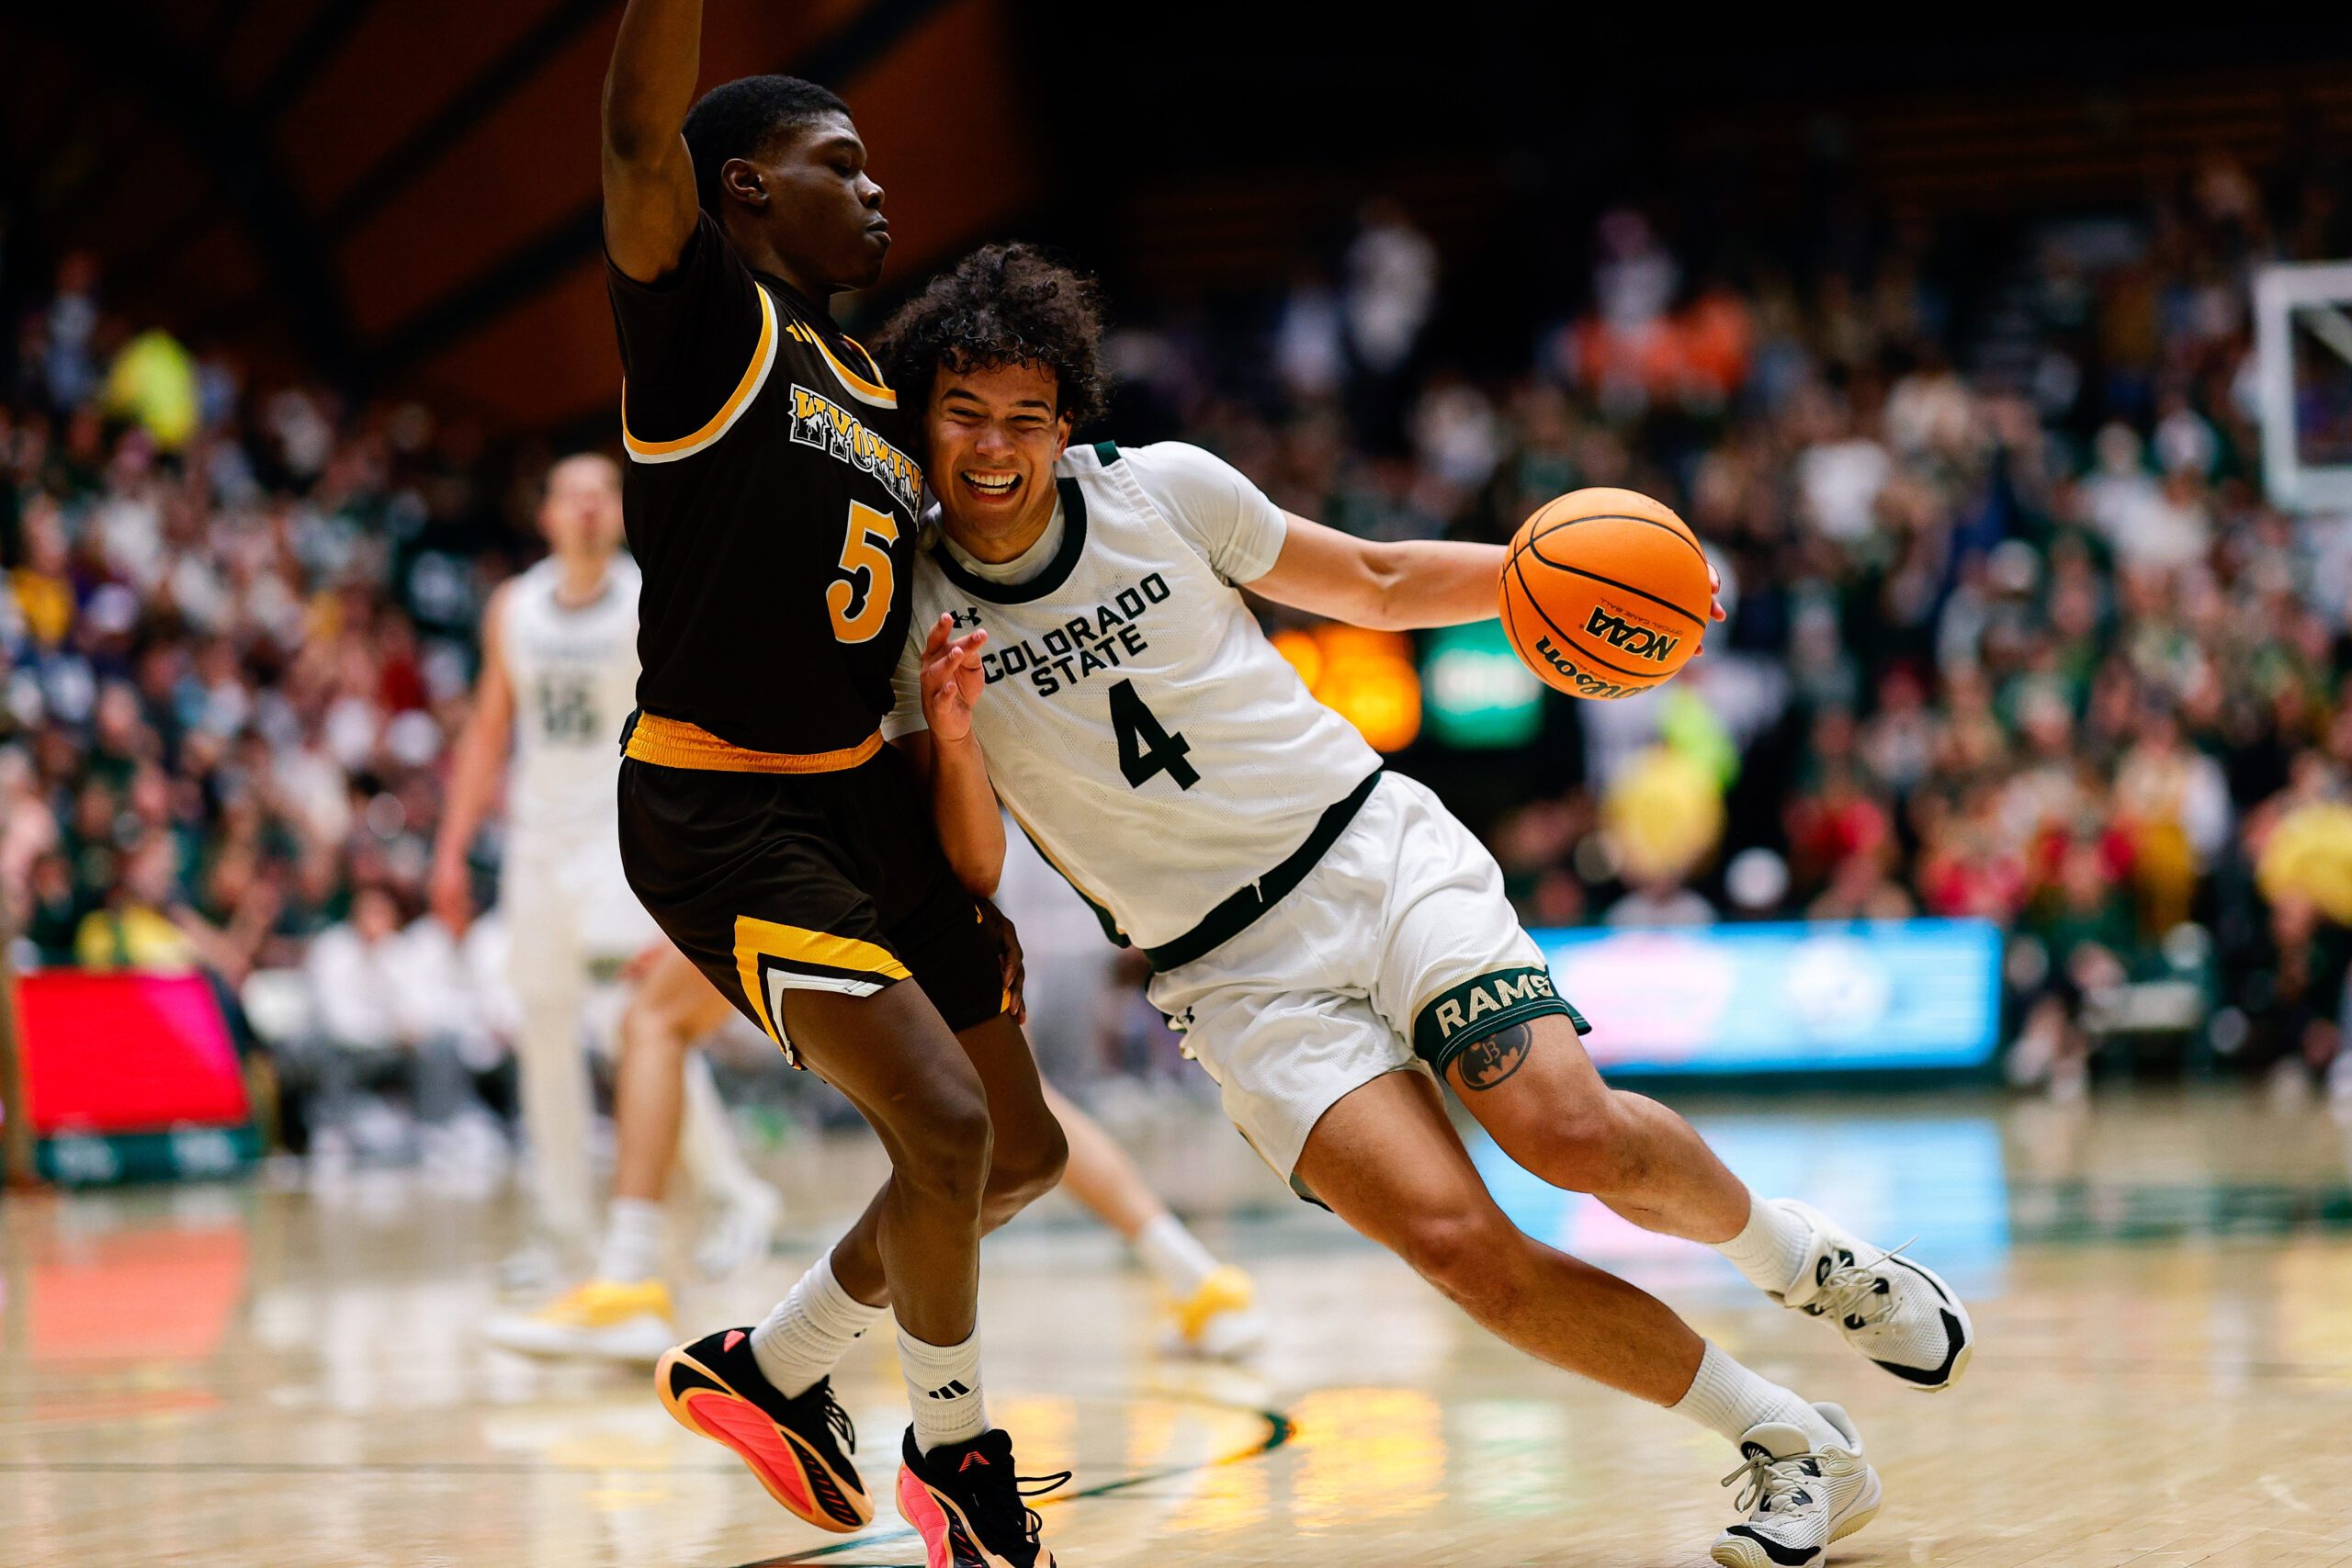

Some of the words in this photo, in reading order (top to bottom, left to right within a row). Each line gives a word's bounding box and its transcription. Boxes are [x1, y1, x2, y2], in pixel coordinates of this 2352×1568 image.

[789, 382, 923, 533] WYOMIN
[826, 499, 900, 643] 5
[981, 572, 1171, 685] COLORADO
[1031, 624, 1148, 698] STATE
[1584, 605, 1680, 663] NCAA
[1108, 678, 1202, 792] 4
[1435, 974, 1555, 1039] RAMS
